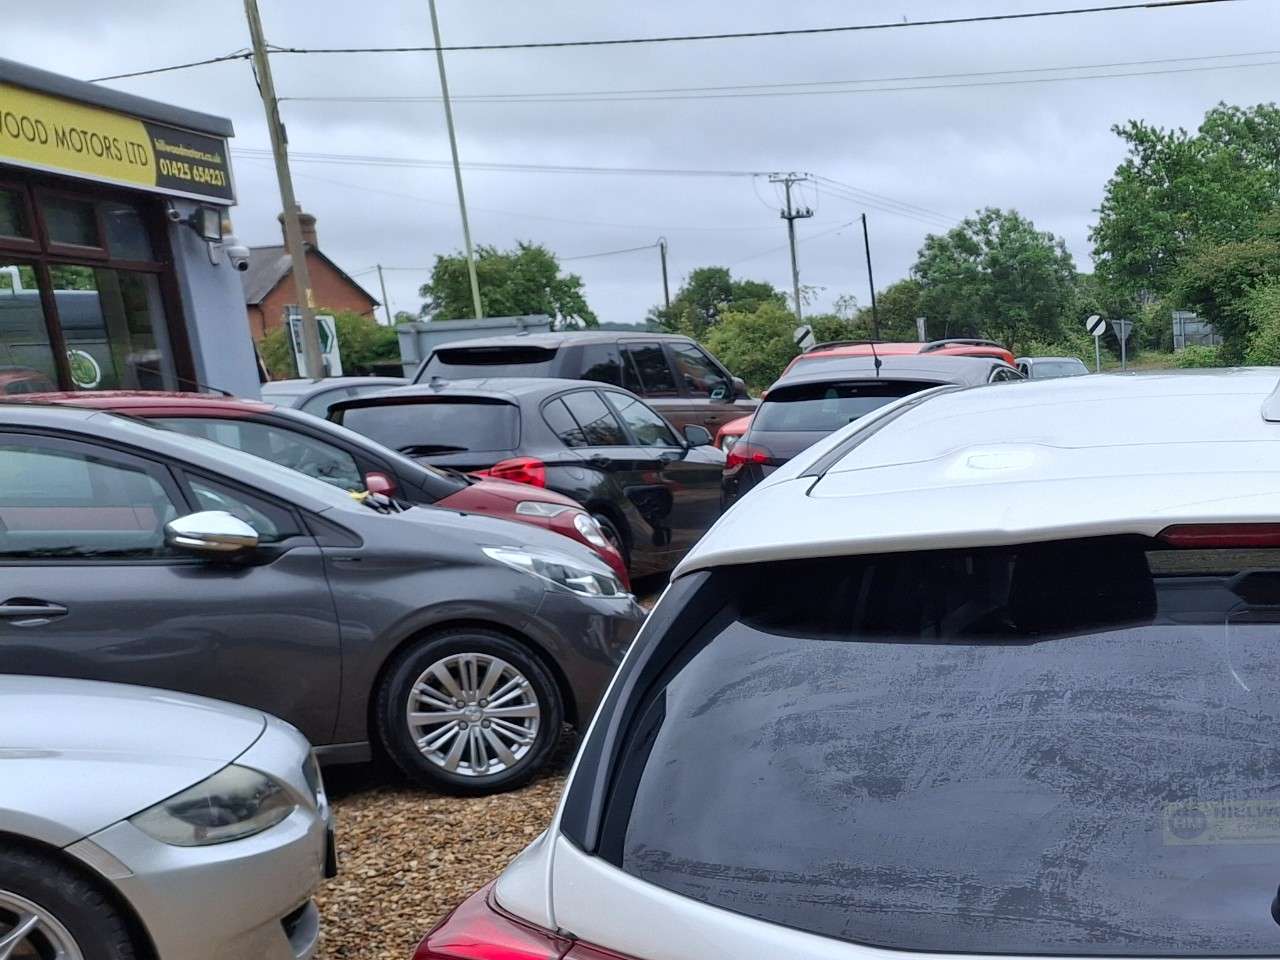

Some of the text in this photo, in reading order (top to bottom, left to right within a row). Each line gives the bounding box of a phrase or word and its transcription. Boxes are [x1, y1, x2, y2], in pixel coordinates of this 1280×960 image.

[0, 111, 149, 167] OOD MOTORS LTD
[160, 158, 226, 187] 01425 654231
